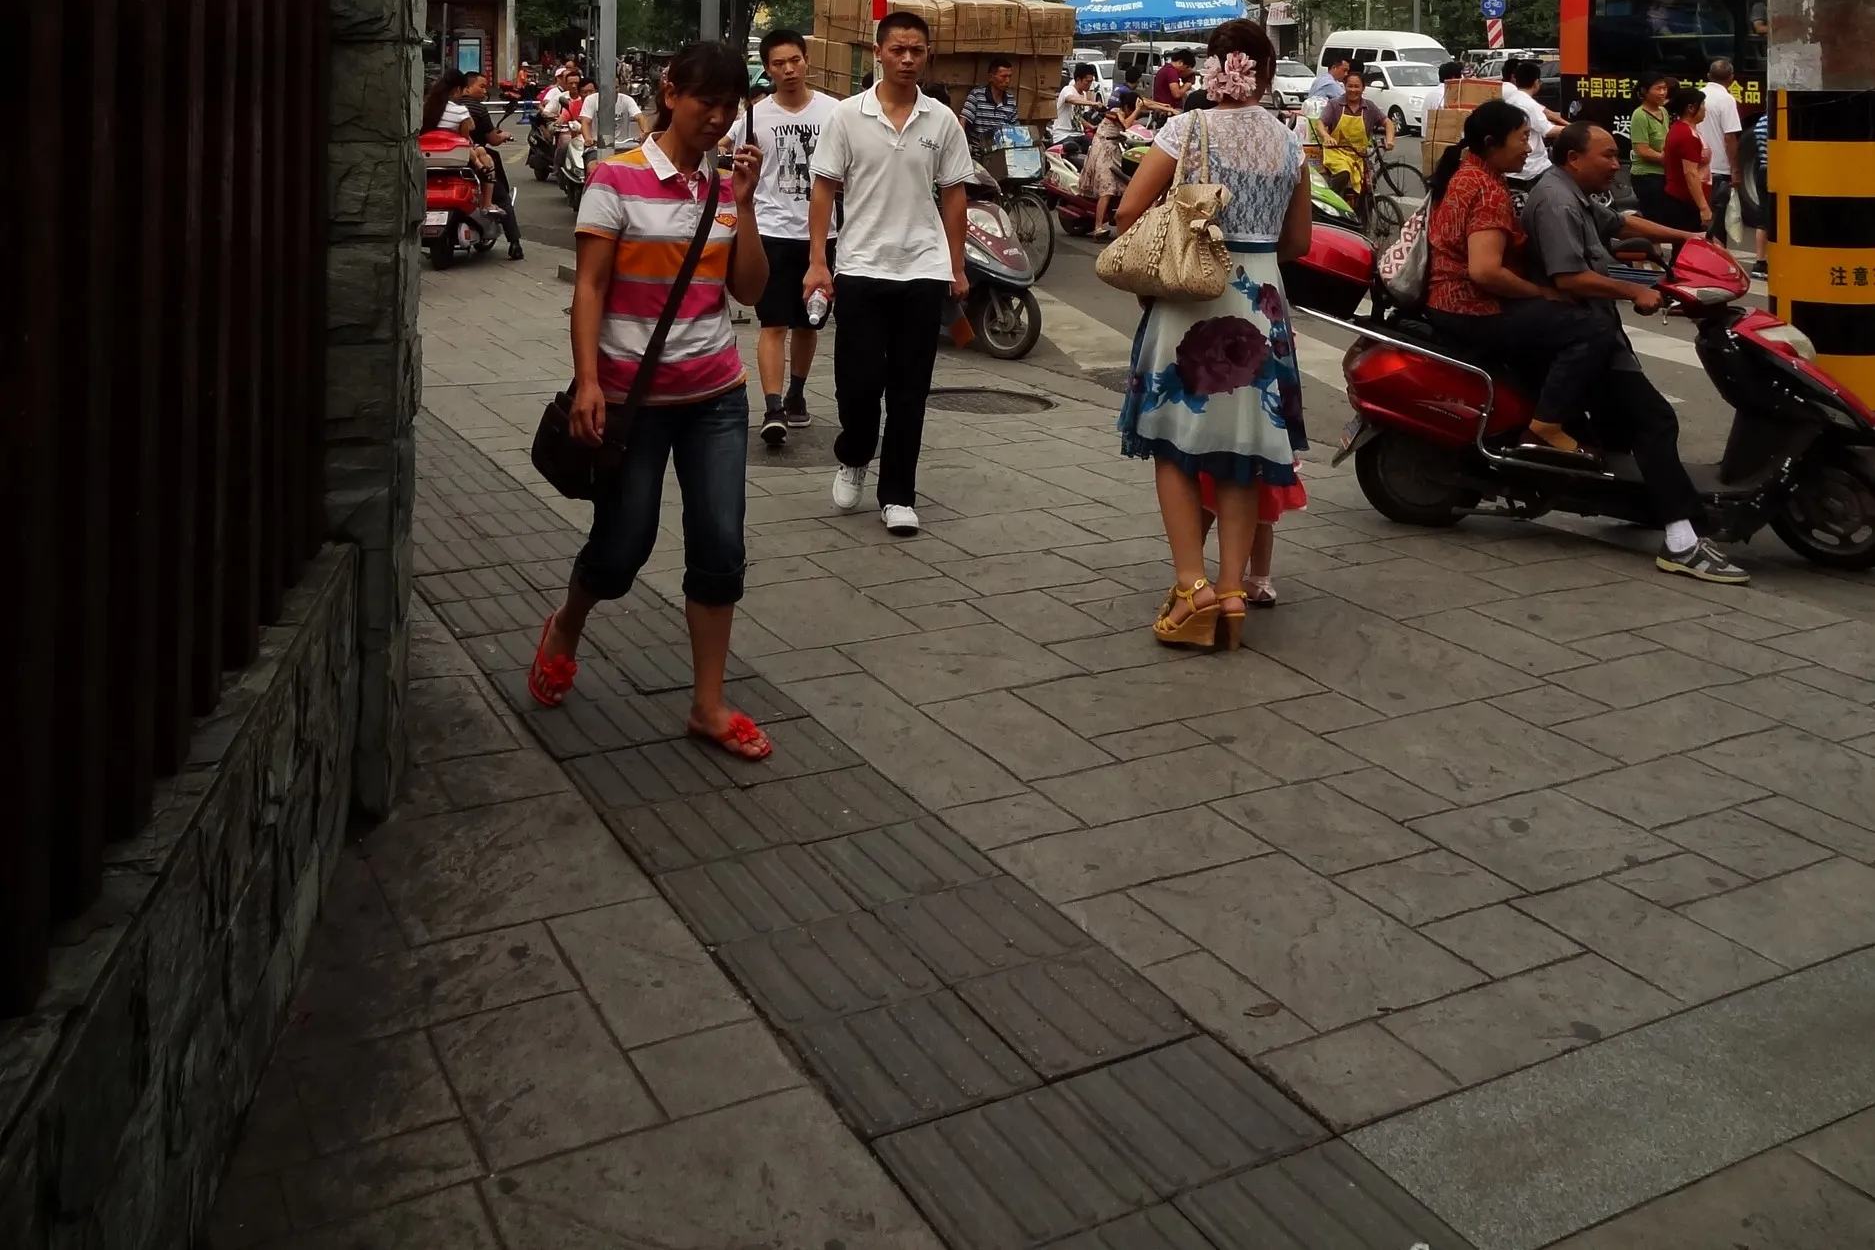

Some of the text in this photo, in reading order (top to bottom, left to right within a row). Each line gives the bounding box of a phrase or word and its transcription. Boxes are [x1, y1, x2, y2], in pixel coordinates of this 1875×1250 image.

[1123, 21, 1157, 30] 文明出行
[1829, 266, 1875, 286] 注意
